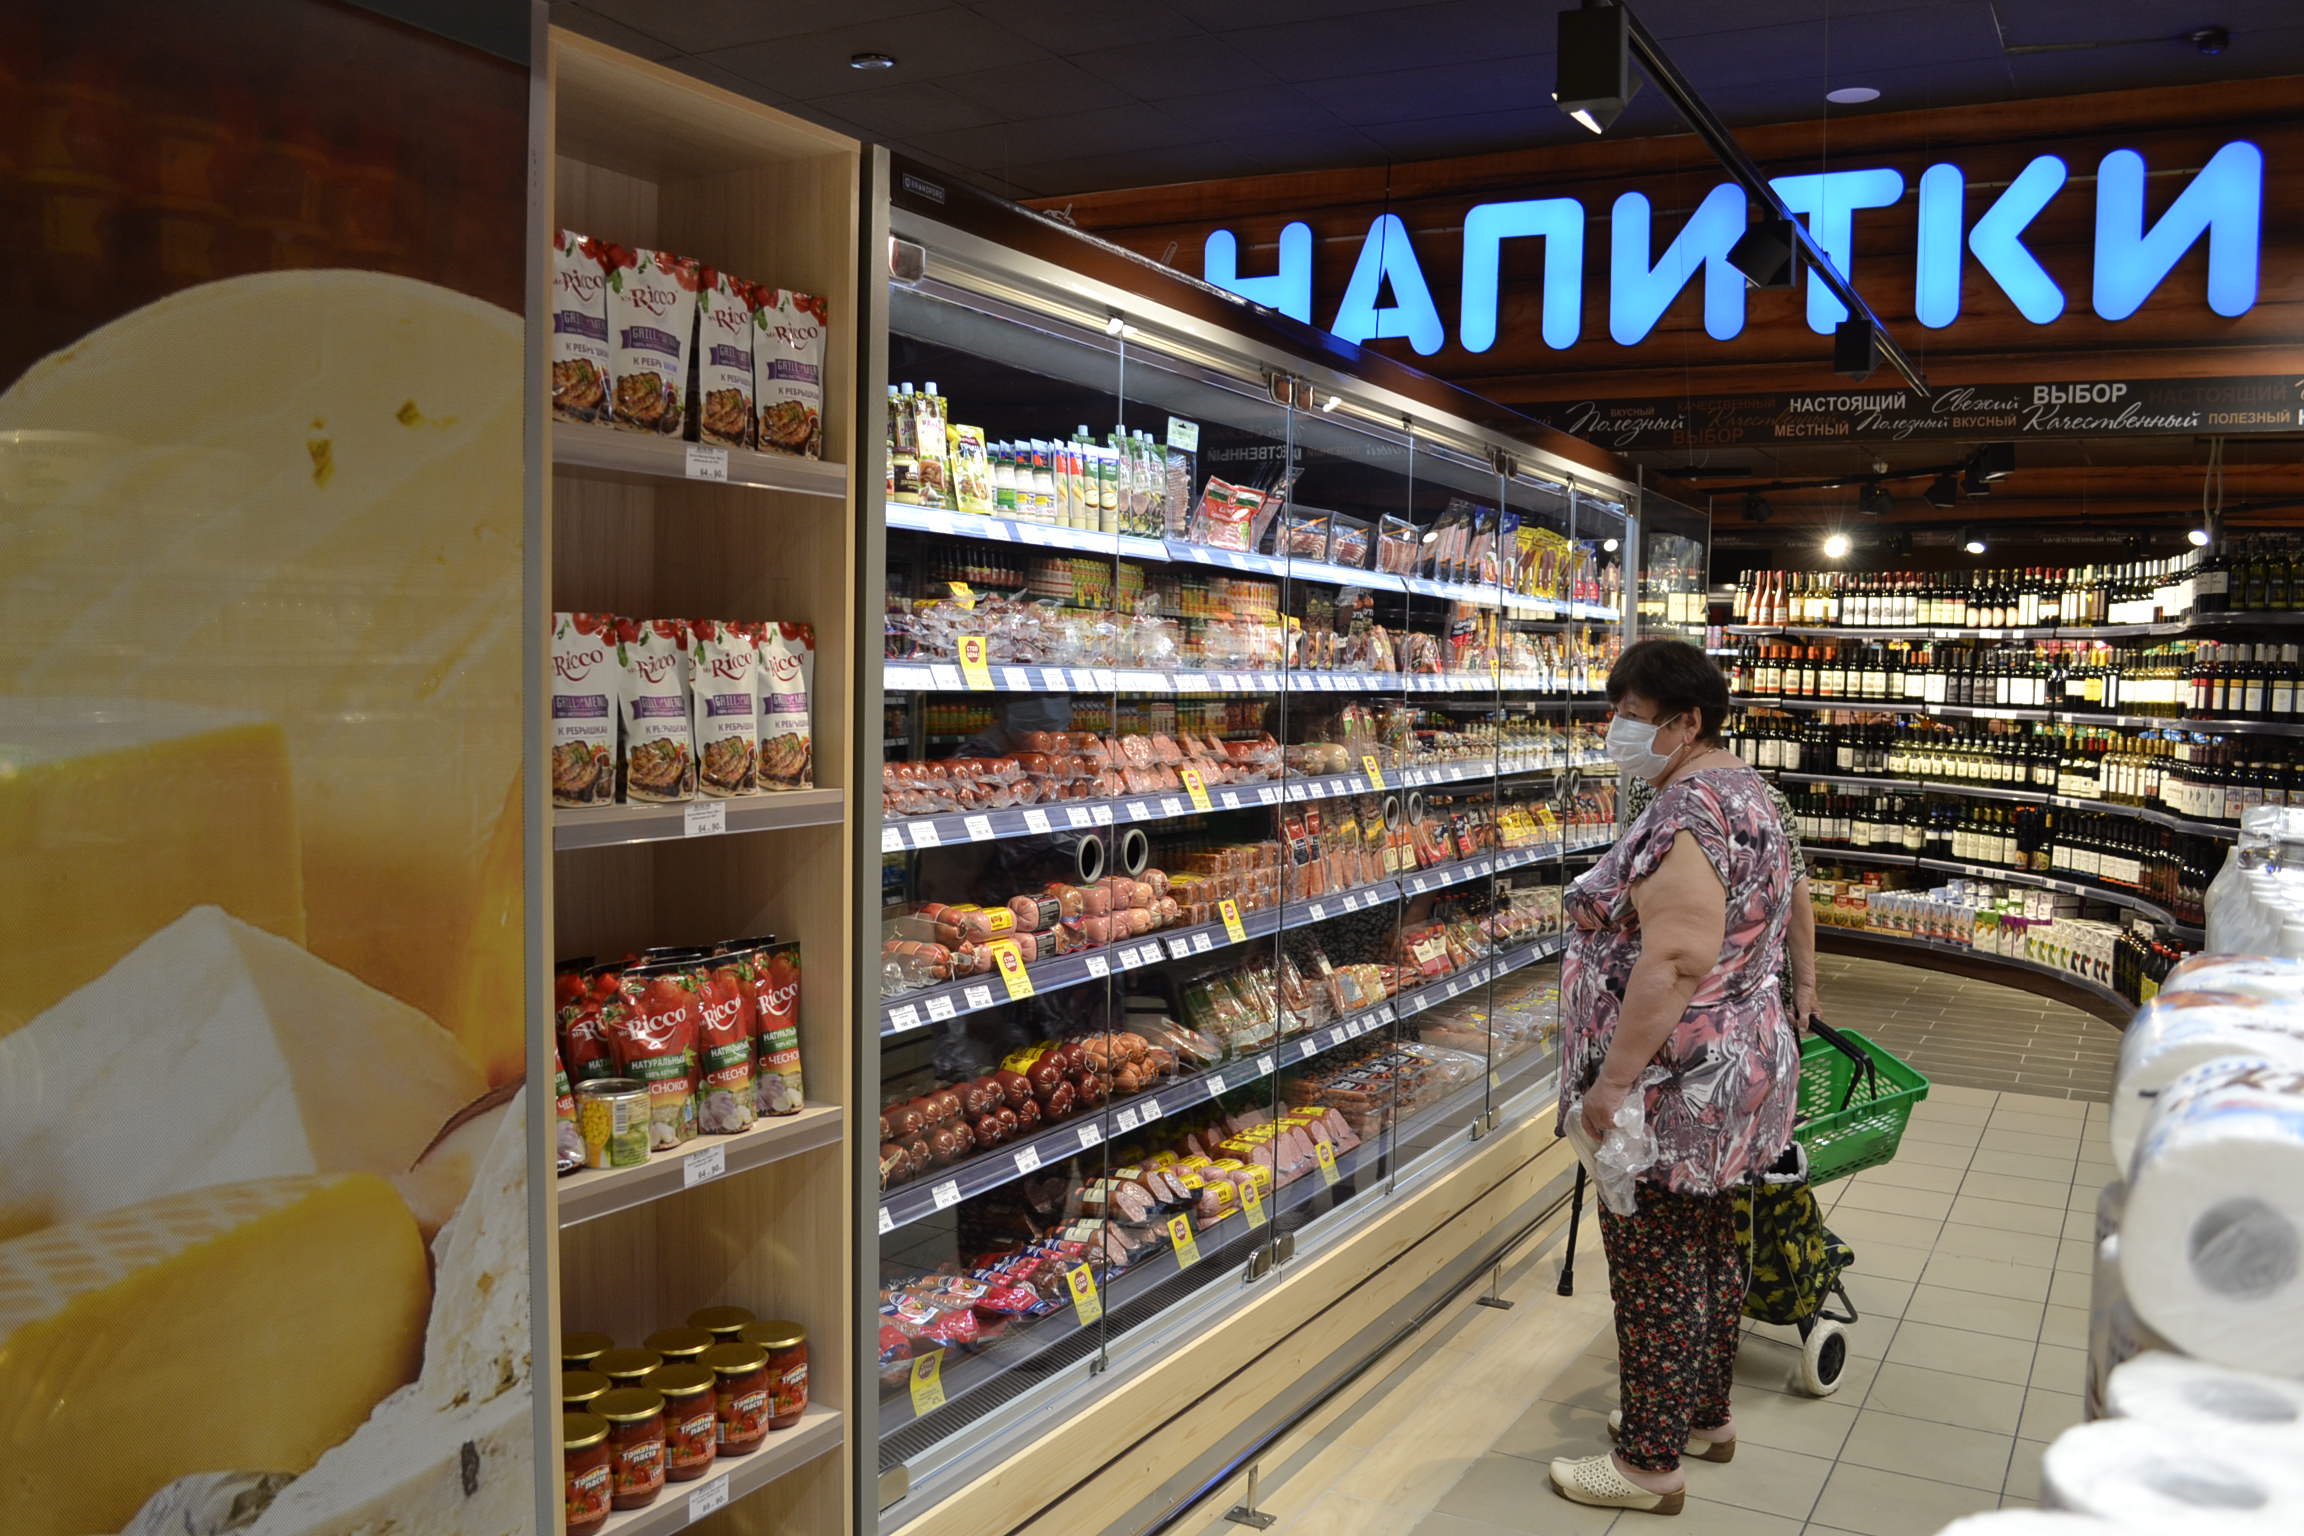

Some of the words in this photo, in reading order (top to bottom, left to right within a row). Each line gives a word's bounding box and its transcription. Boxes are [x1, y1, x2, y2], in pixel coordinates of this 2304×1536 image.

[1204, 138, 2264, 356] НАПИТКИ
[629, 284, 677, 316] Ricco
[1789, 391, 1906, 414] НАСТОЯЩИЙ
[1931, 387, 2022, 414] Свежий
[2033, 383, 2127, 405] ВЫБОР
[1566, 400, 1687, 447] Полезный
[1609, 406, 1656, 418] ВКУСНЫЙ
[1855, 408, 1950, 441] Полезный
[1952, 414, 2017, 428] ВКУСНЫЙ
[2022, 401, 2200, 431] Качественный
[2208, 410, 2291, 425] ПОЛЕЗНЫЙ
[1672, 426, 1745, 446] ВЫБОР
[1774, 421, 1850, 437] МЕСТНЫЙ
[552, 649, 604, 682] Ricco
[636, 654, 677, 684] Ricco
[711, 652, 753, 681] Ricco
[702, 994, 742, 1031] Ricco
[758, 983, 799, 1016] Ricco
[625, 1007, 687, 1042] Ricco
[759, 1058, 768, 1067] С
[707, 1074, 716, 1085] С
